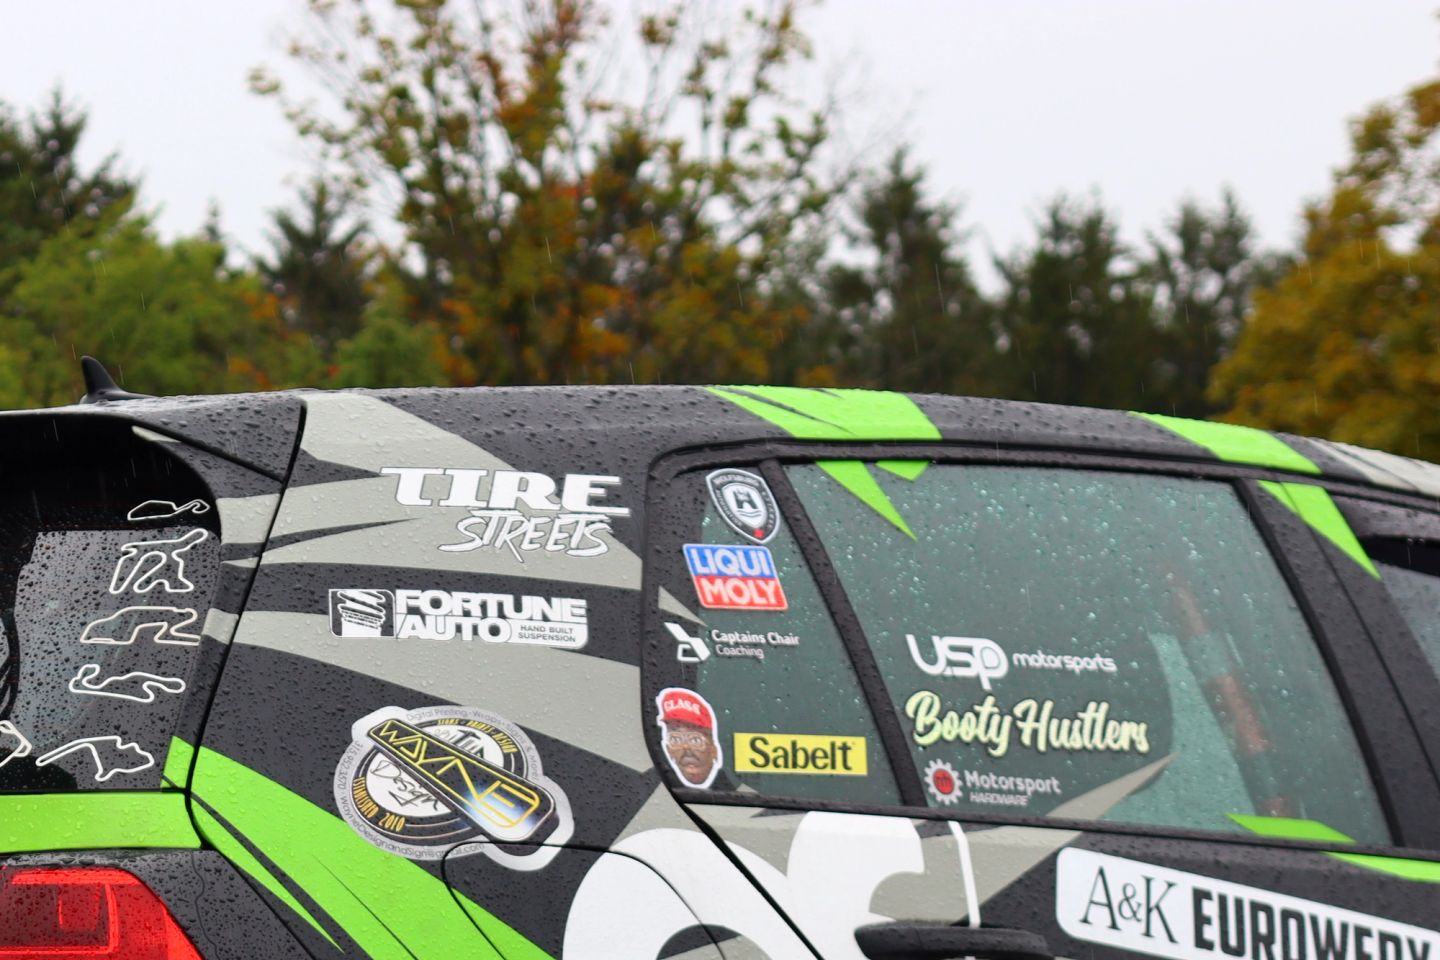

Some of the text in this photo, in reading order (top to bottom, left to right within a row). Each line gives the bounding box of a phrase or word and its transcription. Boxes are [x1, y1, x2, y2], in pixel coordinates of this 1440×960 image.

[380, 467, 630, 516] TIRE
[438, 509, 613, 562] STREETS
[690, 548, 769, 575] LIQUI
[700, 578, 779, 605] MOLY
[395, 589, 587, 623] FORTUNE
[397, 614, 511, 642] AUTO
[518, 632, 576, 642] SUSPENSION
[520, 624, 574, 635] HAND BUILT
[711, 629, 800, 645] Captains Chair
[715, 644, 764, 659] Coaching
[905, 634, 1117, 690] USP motorsports
[905, 691, 1149, 757] Booty Hustlers
[748, 736, 852, 771] Sabelt
[374, 720, 540, 829] WAYNE
[964, 770, 1062, 795] Motorsport
[970, 792, 1029, 806] HARDWARE
[378, 812, 406, 833] 2010
[1080, 865, 1180, 945] A&K
